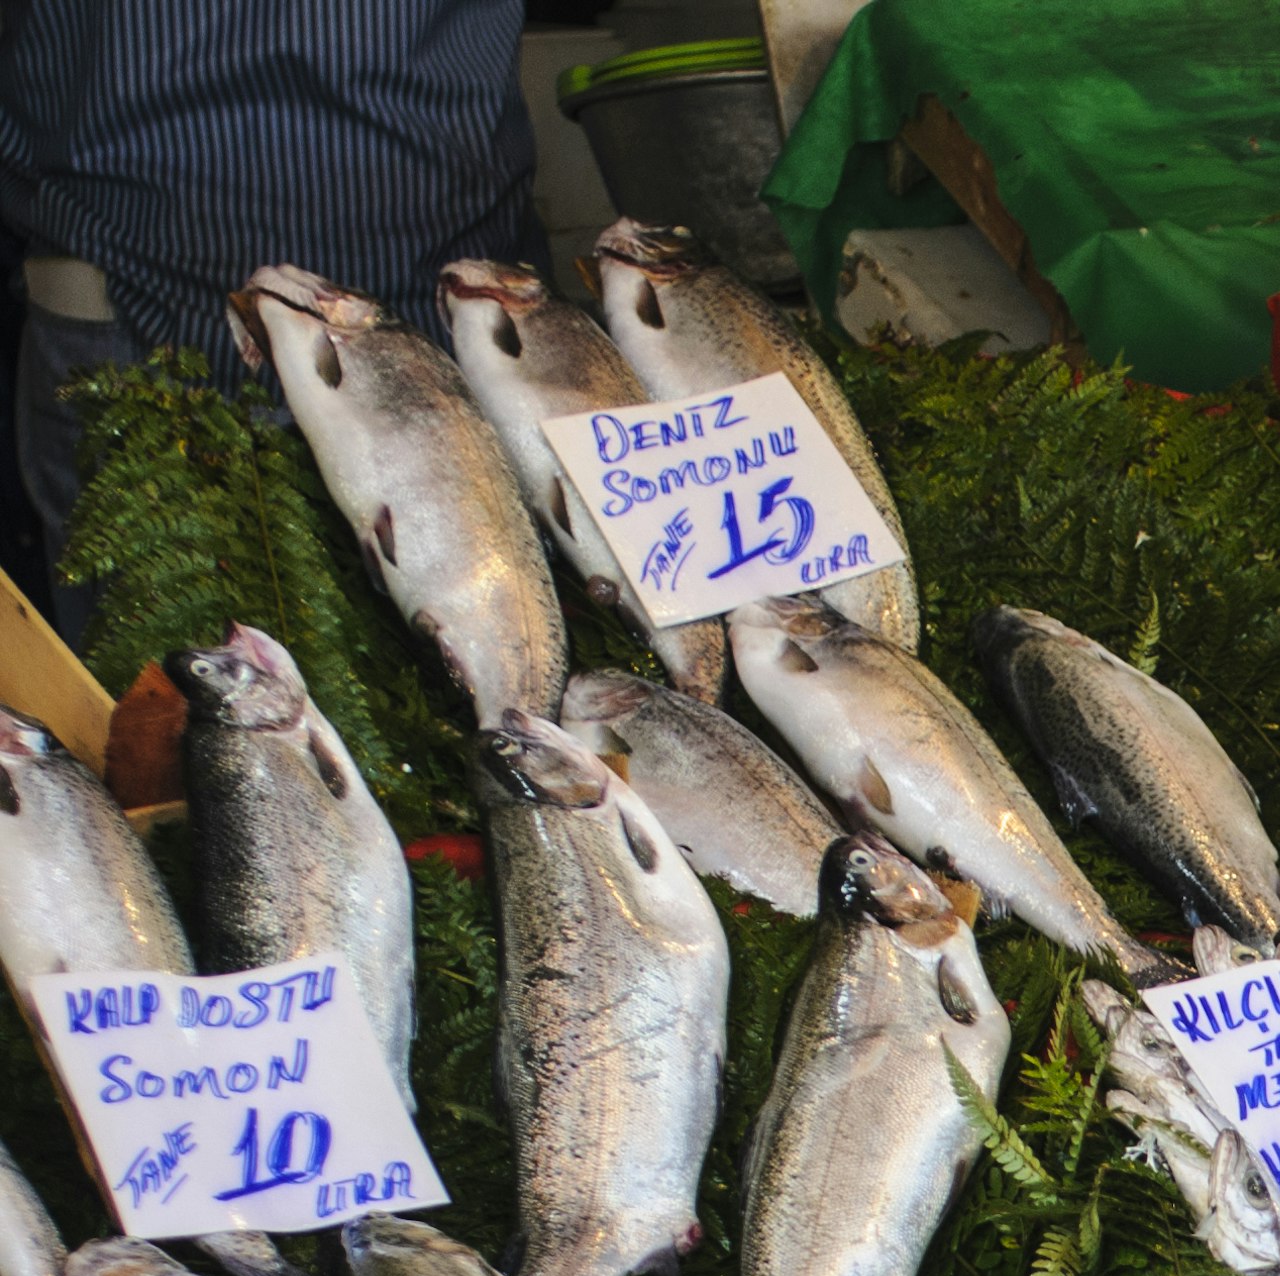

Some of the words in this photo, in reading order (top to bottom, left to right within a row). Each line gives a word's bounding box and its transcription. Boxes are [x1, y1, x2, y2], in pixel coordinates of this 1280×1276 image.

[707, 476, 816, 579] 15
[66, 983, 160, 1034] KALP
[176, 966, 337, 1030] DOSTU
[113, 1121, 197, 1210] TANE
[213, 1107, 333, 1201] 10
